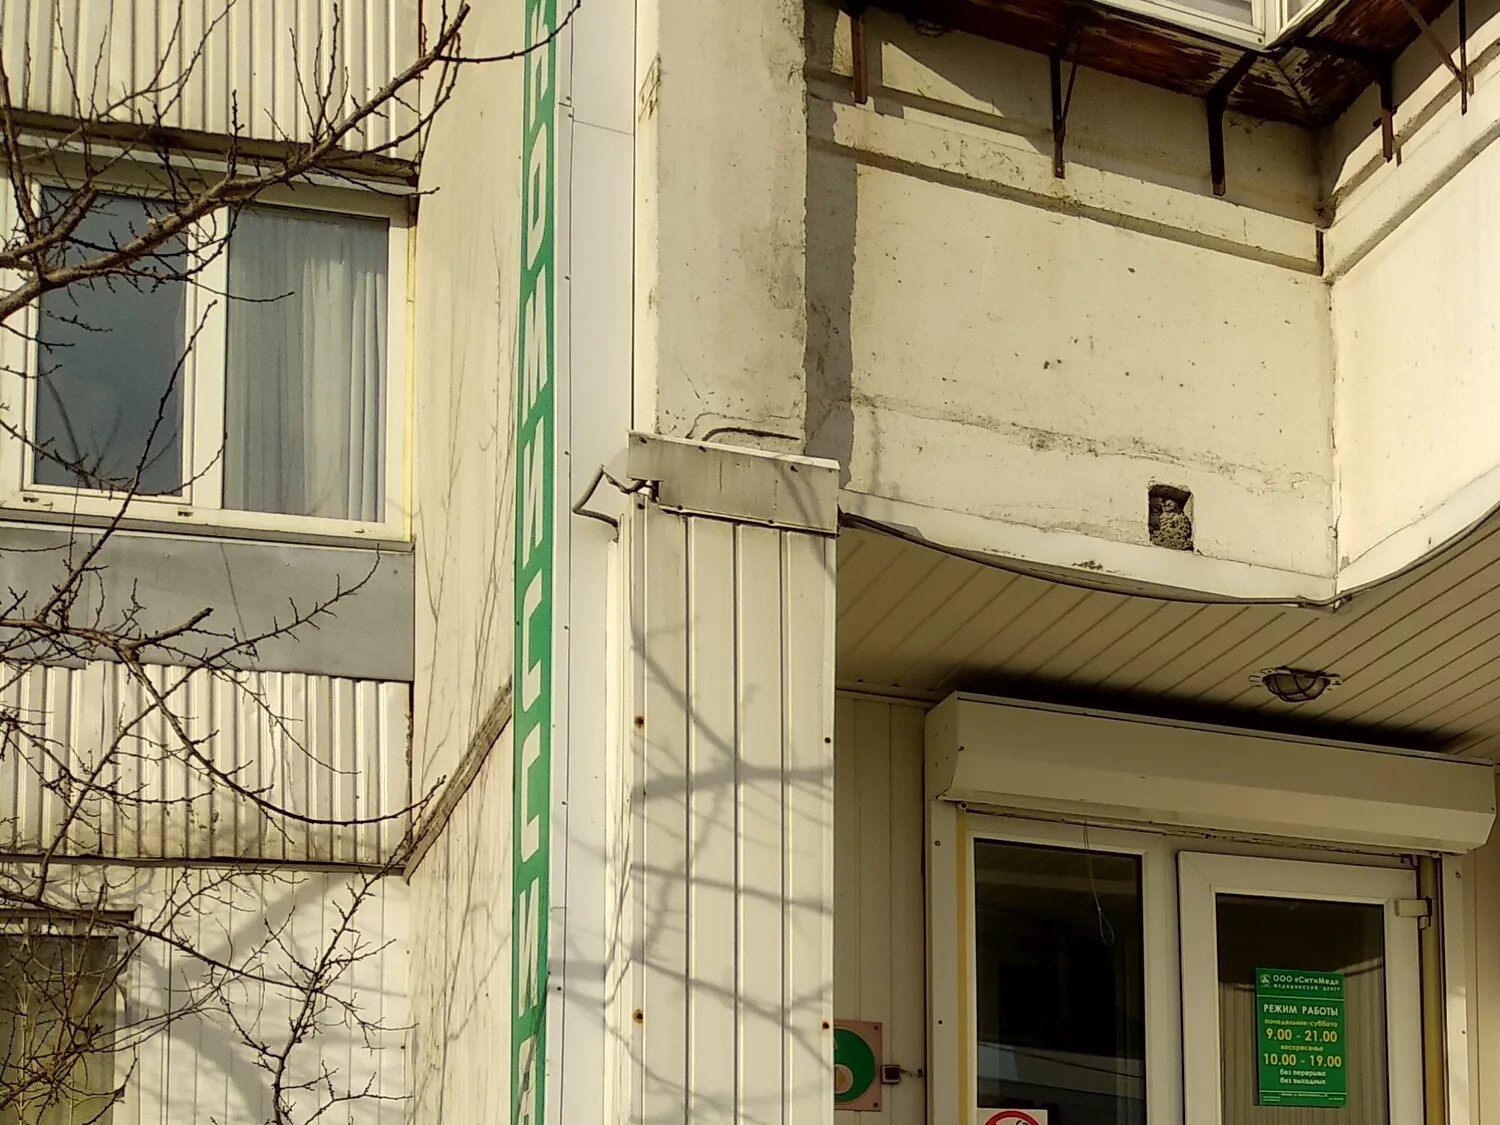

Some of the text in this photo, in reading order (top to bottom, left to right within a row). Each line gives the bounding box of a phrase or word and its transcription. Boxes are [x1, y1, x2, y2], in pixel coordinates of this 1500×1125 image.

[1273, 974, 1293, 983] ООО
[1263, 1004, 1339, 1016] РЕЖИМ РАБОТЫ
[1266, 1027, 1292, 1040] 9.00
[1304, 1030, 1338, 1042] 21.00
[1280, 1044, 1324, 1052] воскресенье
[1263, 1053, 1297, 1066] 10.00
[1310, 1055, 1342, 1067] 19.00
[1280, 1068, 1292, 1076] без
[1293, 1078, 1326, 1086] выходных
